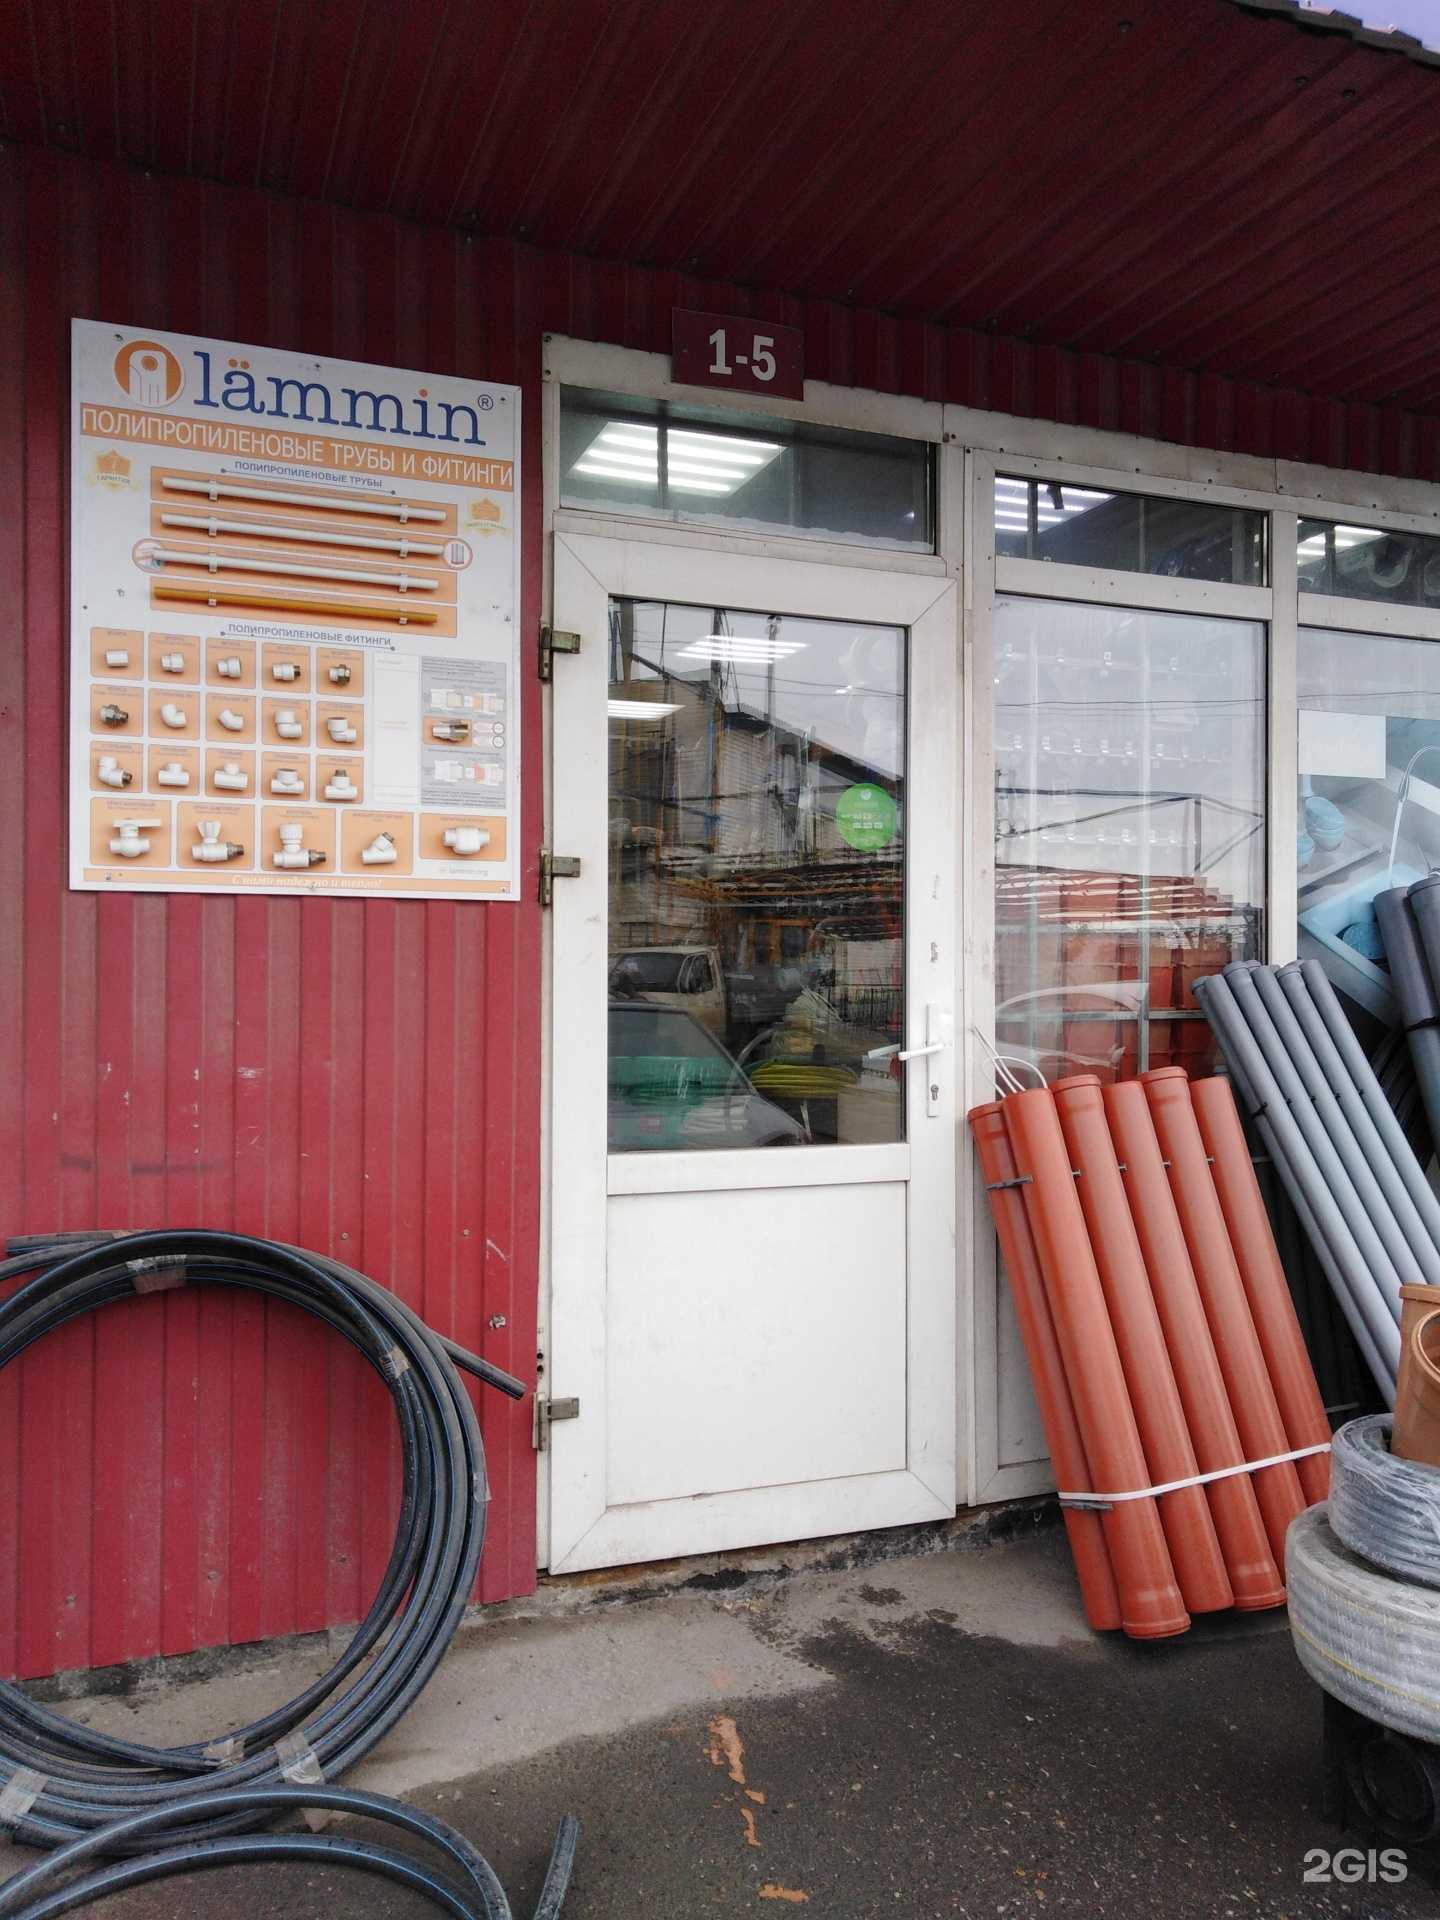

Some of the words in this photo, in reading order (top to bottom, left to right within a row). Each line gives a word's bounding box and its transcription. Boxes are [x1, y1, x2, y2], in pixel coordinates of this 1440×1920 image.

[709, 329, 777, 381] 1-5
[81, 407, 325, 463] ПОЛИПРОПИЛЕНОВЫЕ
[330, 442, 395, 472] ТРУБЫ
[402, 452, 416, 475] И
[422, 455, 514, 487] ФИТИНГИ
[234, 460, 348, 483] ПОЛИПРОПИЛЕНОВЫЕ
[349, 475, 383, 488] ТРУБЫ
[228, 623, 342, 642] ПОЛИПРОПИЛЕНОВЫЕ
[345, 634, 392, 646] ФИТИНГИ
